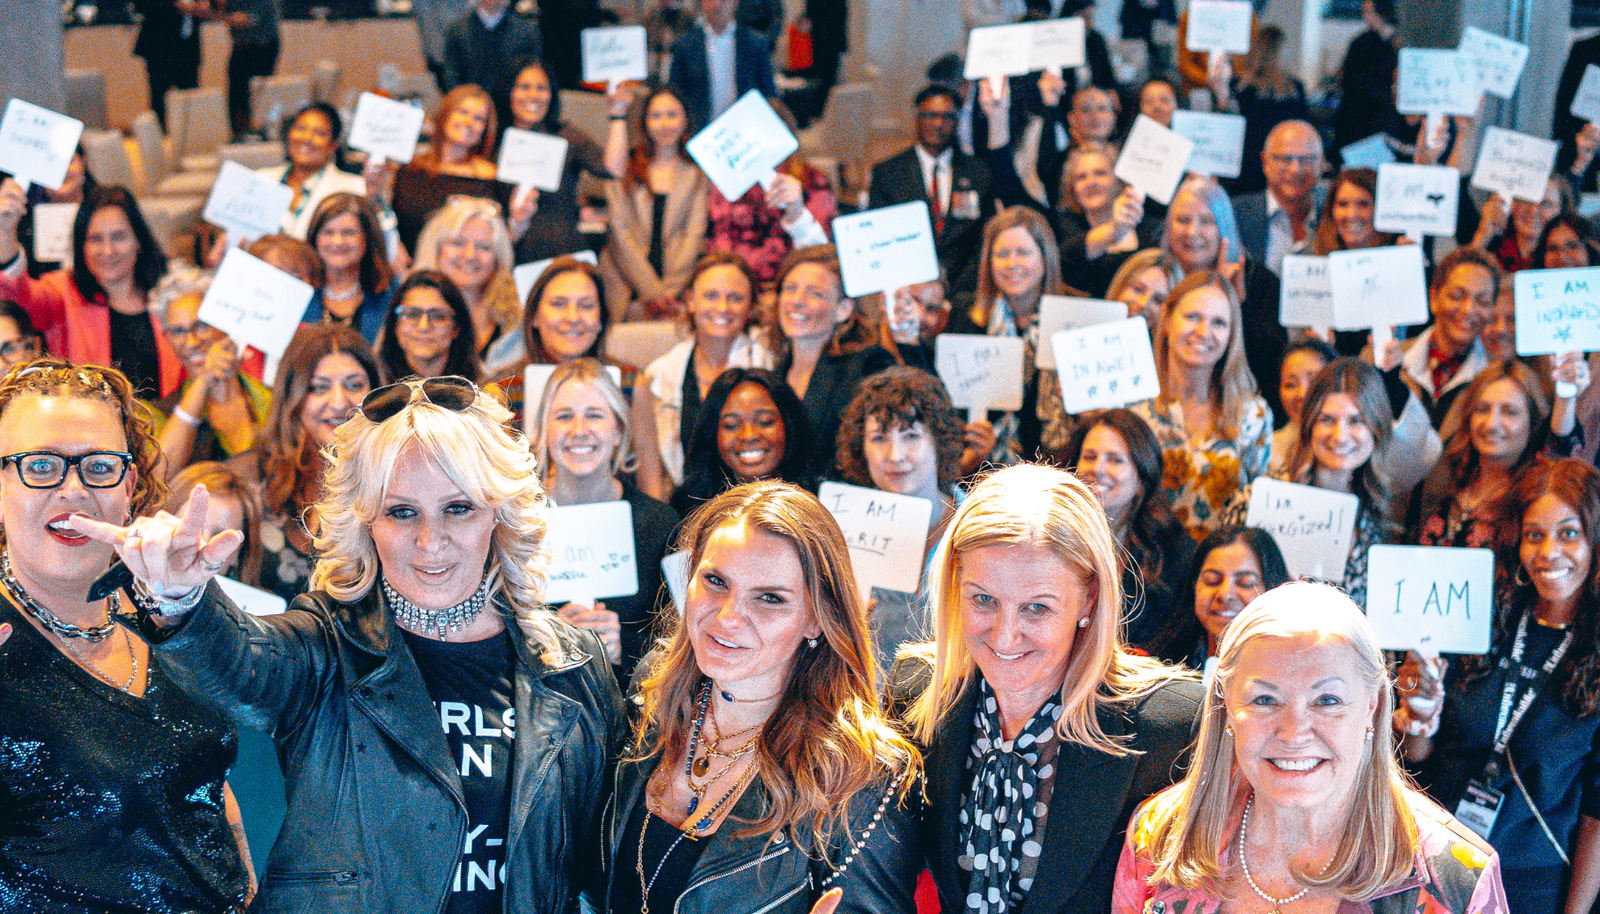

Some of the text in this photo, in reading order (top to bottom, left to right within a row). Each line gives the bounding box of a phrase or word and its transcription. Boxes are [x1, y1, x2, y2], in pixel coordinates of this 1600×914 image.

[1531, 279, 1590, 301] I AM
[1078, 333, 1121, 350] I AM
[1072, 361, 1090, 379] IN
[832, 493, 897, 521] I AM
[1393, 578, 1471, 620] I AM
[433, 701, 515, 738] RLS
[457, 743, 493, 777] N
[453, 859, 505, 892] IN
